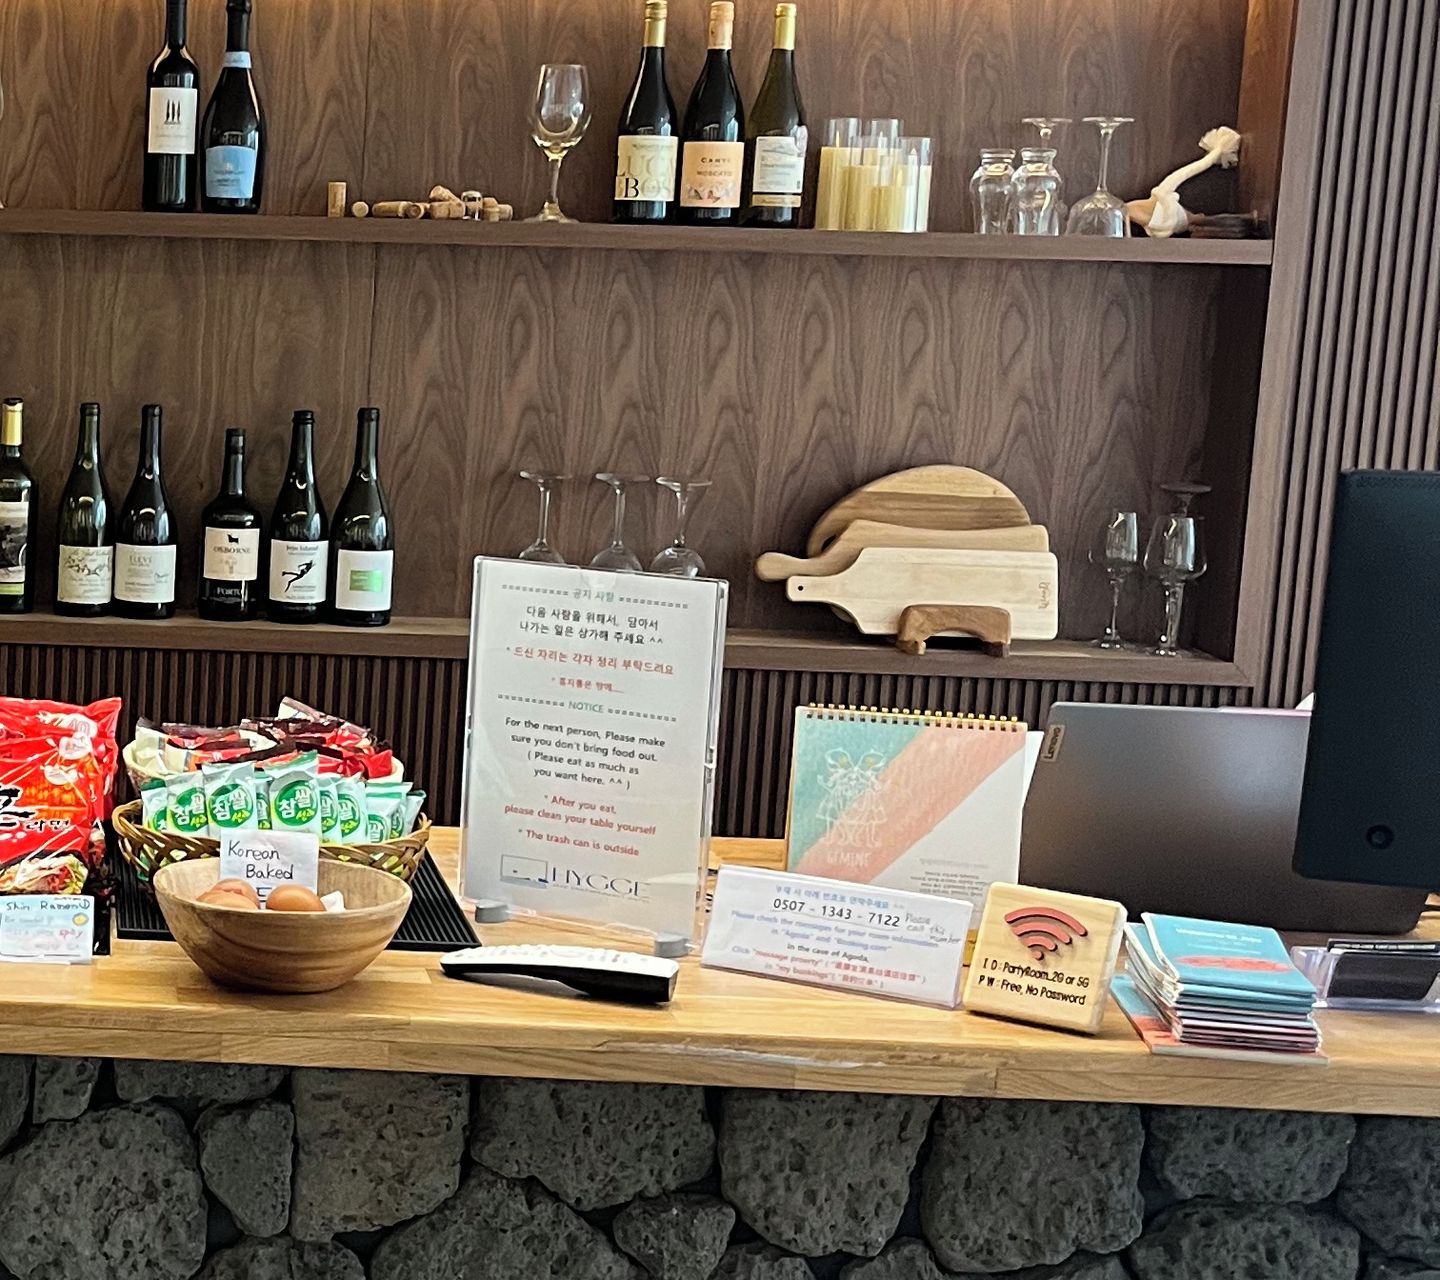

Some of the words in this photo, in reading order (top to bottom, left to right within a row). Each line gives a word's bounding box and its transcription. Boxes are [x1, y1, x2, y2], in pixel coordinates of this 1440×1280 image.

[526, 606, 546, 618] 다음
[551, 608, 581, 622] 사람을
[627, 616, 658, 631] 담아서
[520, 621, 550, 634] 나가는
[554, 624, 574, 637] 일은
[613, 631, 645, 645] 주세요
[514, 647, 534, 659] 드신
[537, 649, 567, 663] 자리는
[572, 653, 593, 666] 각자
[597, 656, 617, 669] 정리
[568, 700, 604, 714] NOTICE
[505, 716, 521, 726] For
[524, 719, 540, 730] the
[543, 723, 564, 733] next
[605, 730, 636, 743] Please
[638, 736, 666, 748] make
[1044, 727, 1061, 759] Lenovo
[511, 734, 531, 744] sure
[534, 737, 552, 747] you
[555, 739, 580, 751] don't
[583, 742, 609, 757] bring
[612, 746, 635, 759] food
[534, 751, 564, 764] Please
[566, 758, 582, 767] eat
[585, 760, 595, 768] as
[598, 762, 626, 773] much
[628, 766, 639, 775] as
[534, 768, 552, 777] you
[554, 771, 578, 781] want
[581, 773, 605, 785] here.
[551, 795, 576, 808] After
[578, 802, 596, 811] you
[25, 819, 70, 832] 라면
[504, 804, 535, 816] please
[537, 809, 562, 820] clean
[564, 814, 587, 824] your
[590, 817, 614, 829] table
[616, 822, 656, 835] yourself
[227, 839, 281, 861] Korean
[526, 829, 544, 840] The
[546, 833, 570, 845] trash
[572, 839, 590, 848] can
[592, 840, 601, 850] is
[603, 843, 640, 856] outside
[245, 864, 295, 880] Baked
[6, 901, 31, 911] Shin
[773, 898, 806, 912] 0507
[822, 905, 853, 920] 1343
[868, 911, 900, 928] 7122
[797, 944, 810, 953] the
[812, 947, 829, 956] case
[830, 950, 840, 958] of
[1065, 976, 1076, 985] or
[1026, 984, 1039, 996] No
[1040, 986, 1087, 1005] Password
